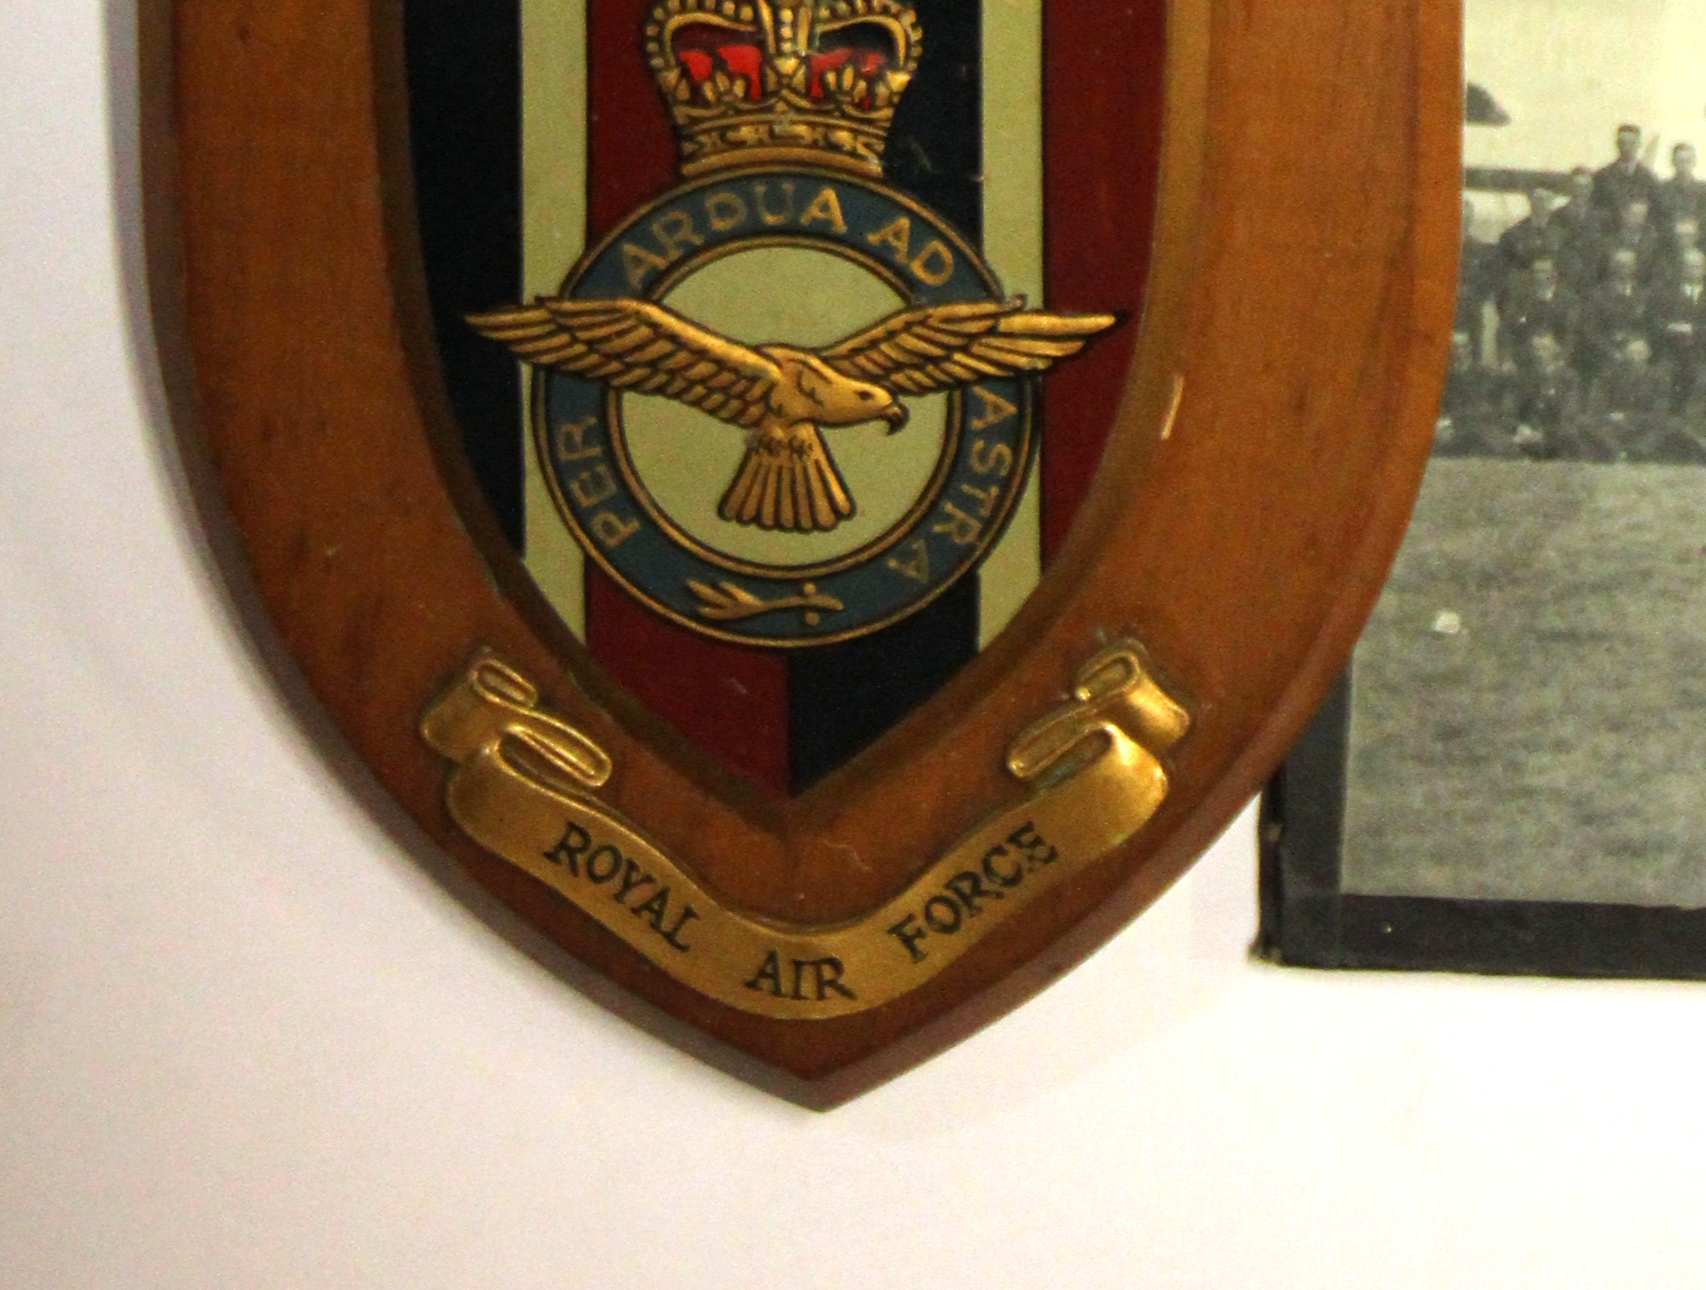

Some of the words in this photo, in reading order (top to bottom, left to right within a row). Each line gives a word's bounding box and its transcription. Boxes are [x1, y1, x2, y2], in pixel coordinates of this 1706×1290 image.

[620, 186, 850, 284] ARDUA
[866, 216, 957, 288] AD
[559, 416, 642, 549] PER
[886, 385, 1020, 587] ASTRA
[543, 820, 702, 952] ROYAL
[744, 948, 857, 1002] AIR
[886, 820, 1061, 963] FORCE
